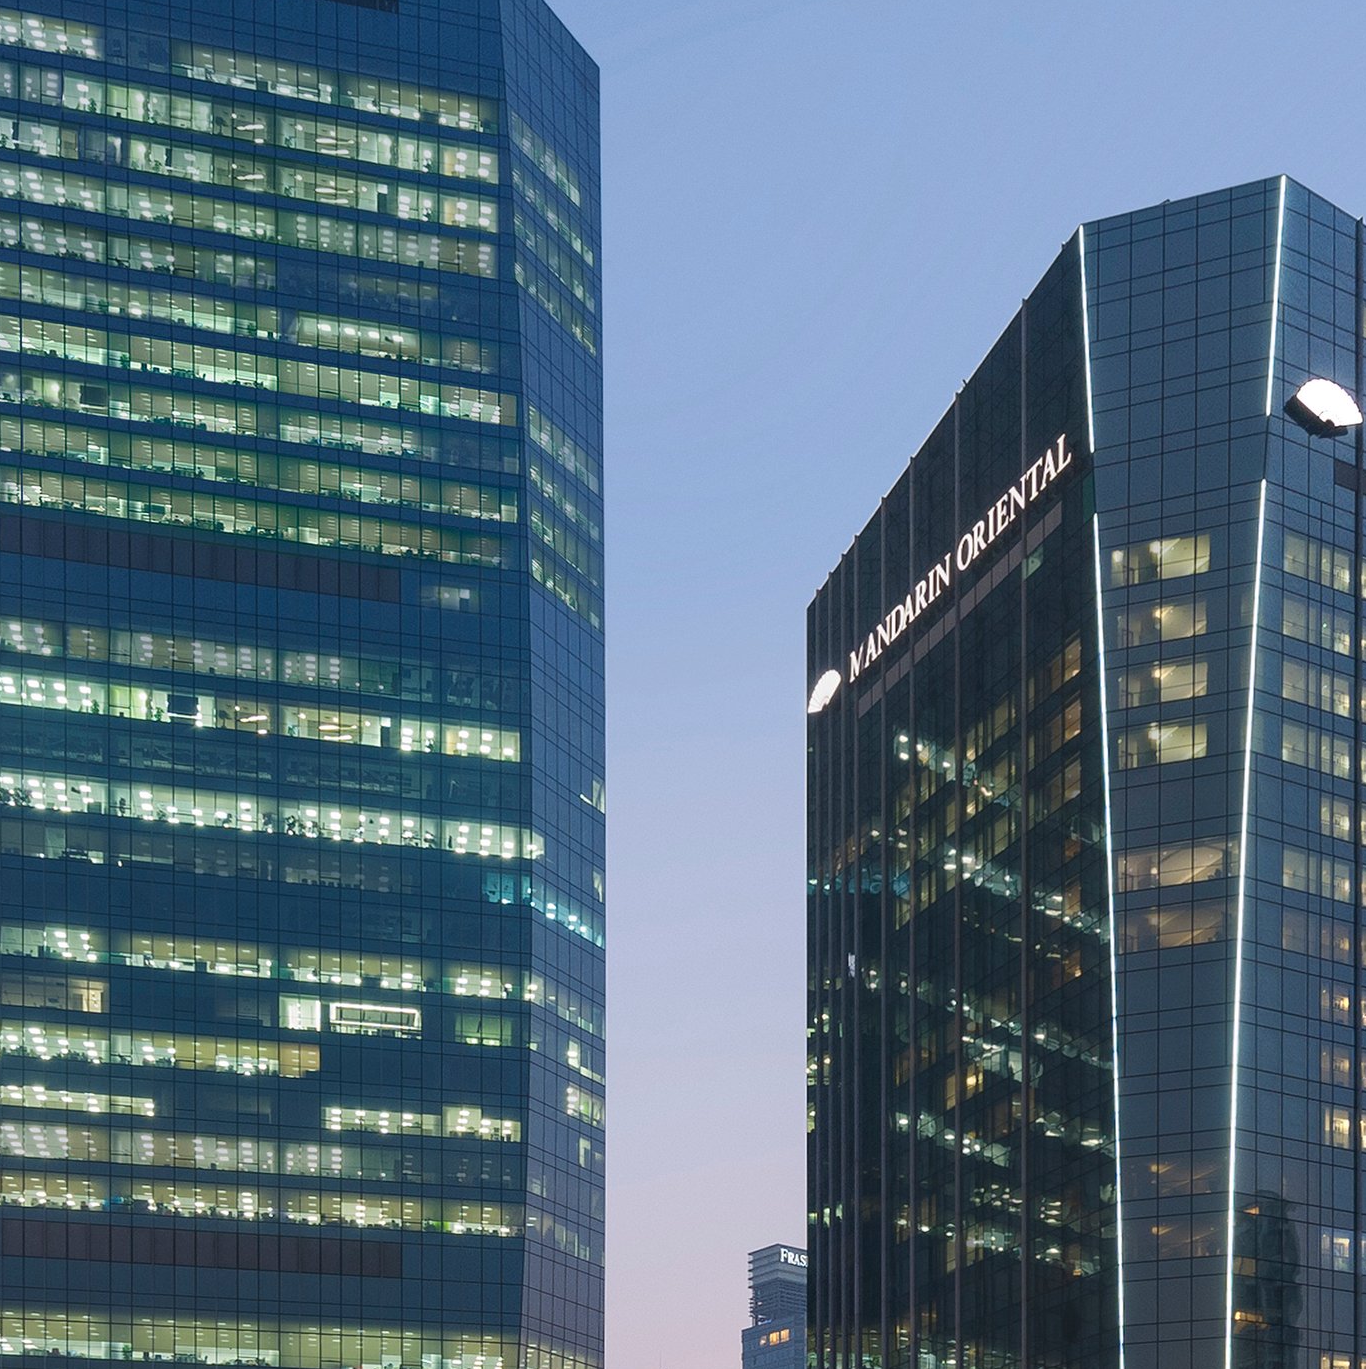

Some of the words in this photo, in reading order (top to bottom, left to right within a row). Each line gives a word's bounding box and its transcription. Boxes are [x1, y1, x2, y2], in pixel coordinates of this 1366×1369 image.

[848, 551, 952, 684] MANDARIN
[956, 432, 1073, 572] ORIENTAL
[780, 1247, 808, 1268] FRAS
